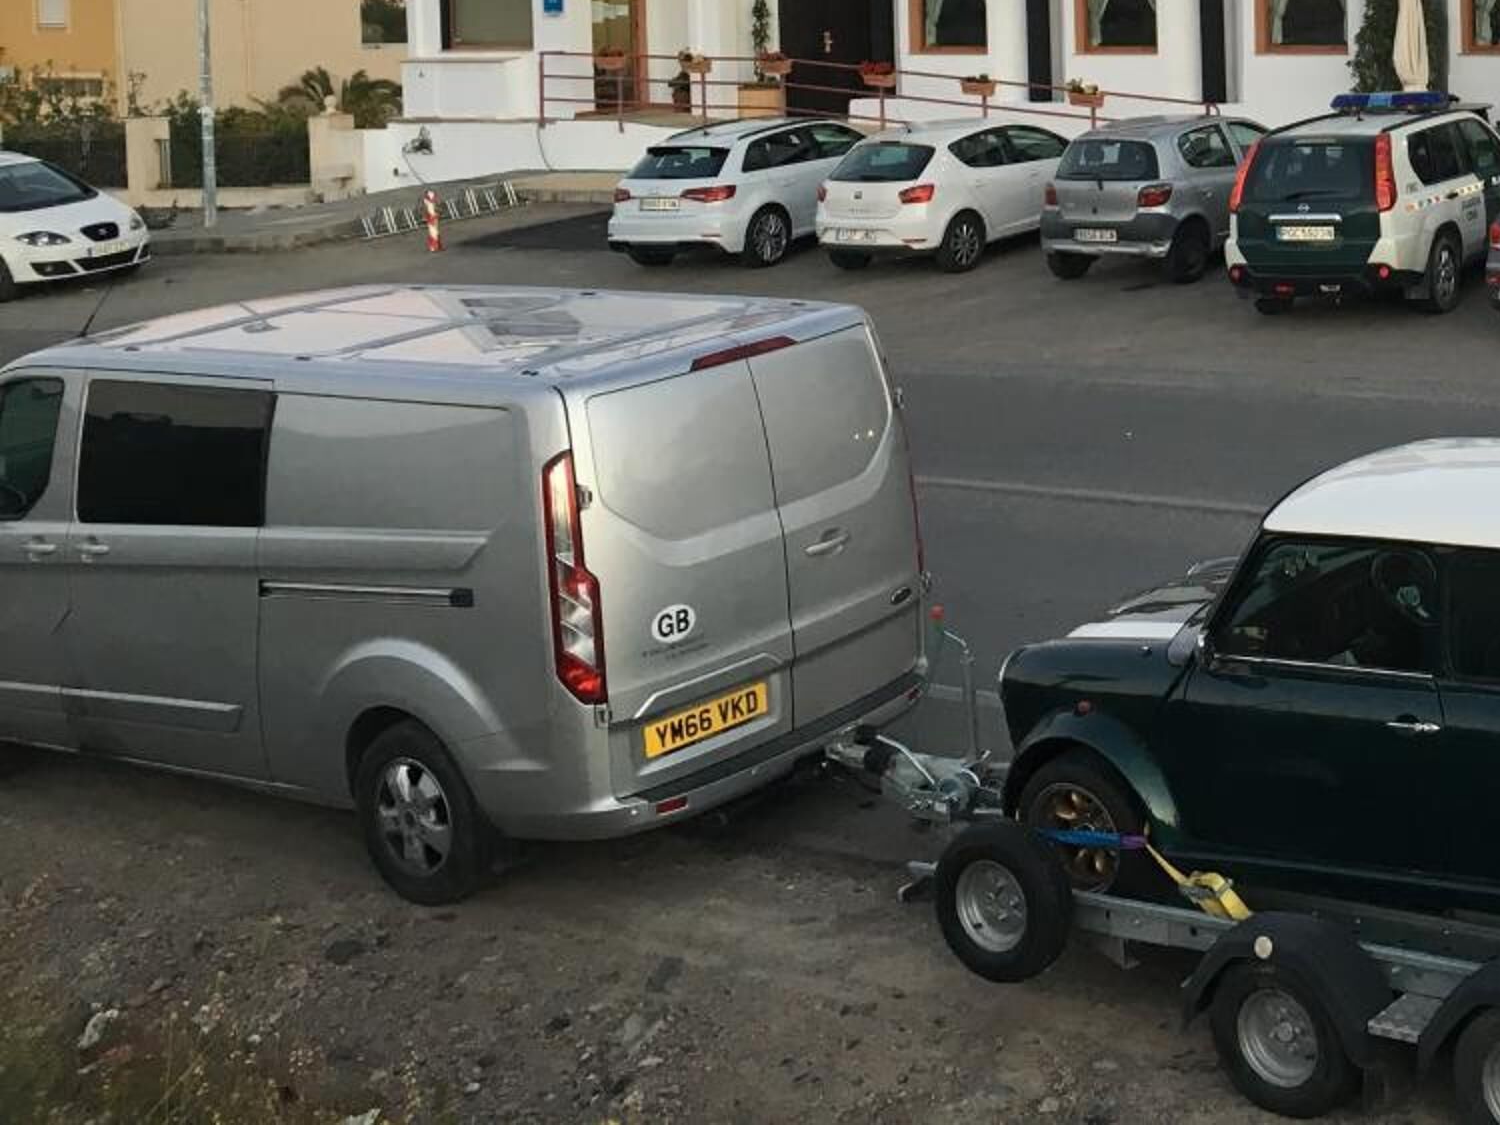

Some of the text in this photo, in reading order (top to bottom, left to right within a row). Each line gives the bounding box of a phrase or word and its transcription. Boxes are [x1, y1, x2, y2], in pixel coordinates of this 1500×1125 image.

[657, 608, 690, 638] GB
[655, 690, 758, 748] YM66 VKD
